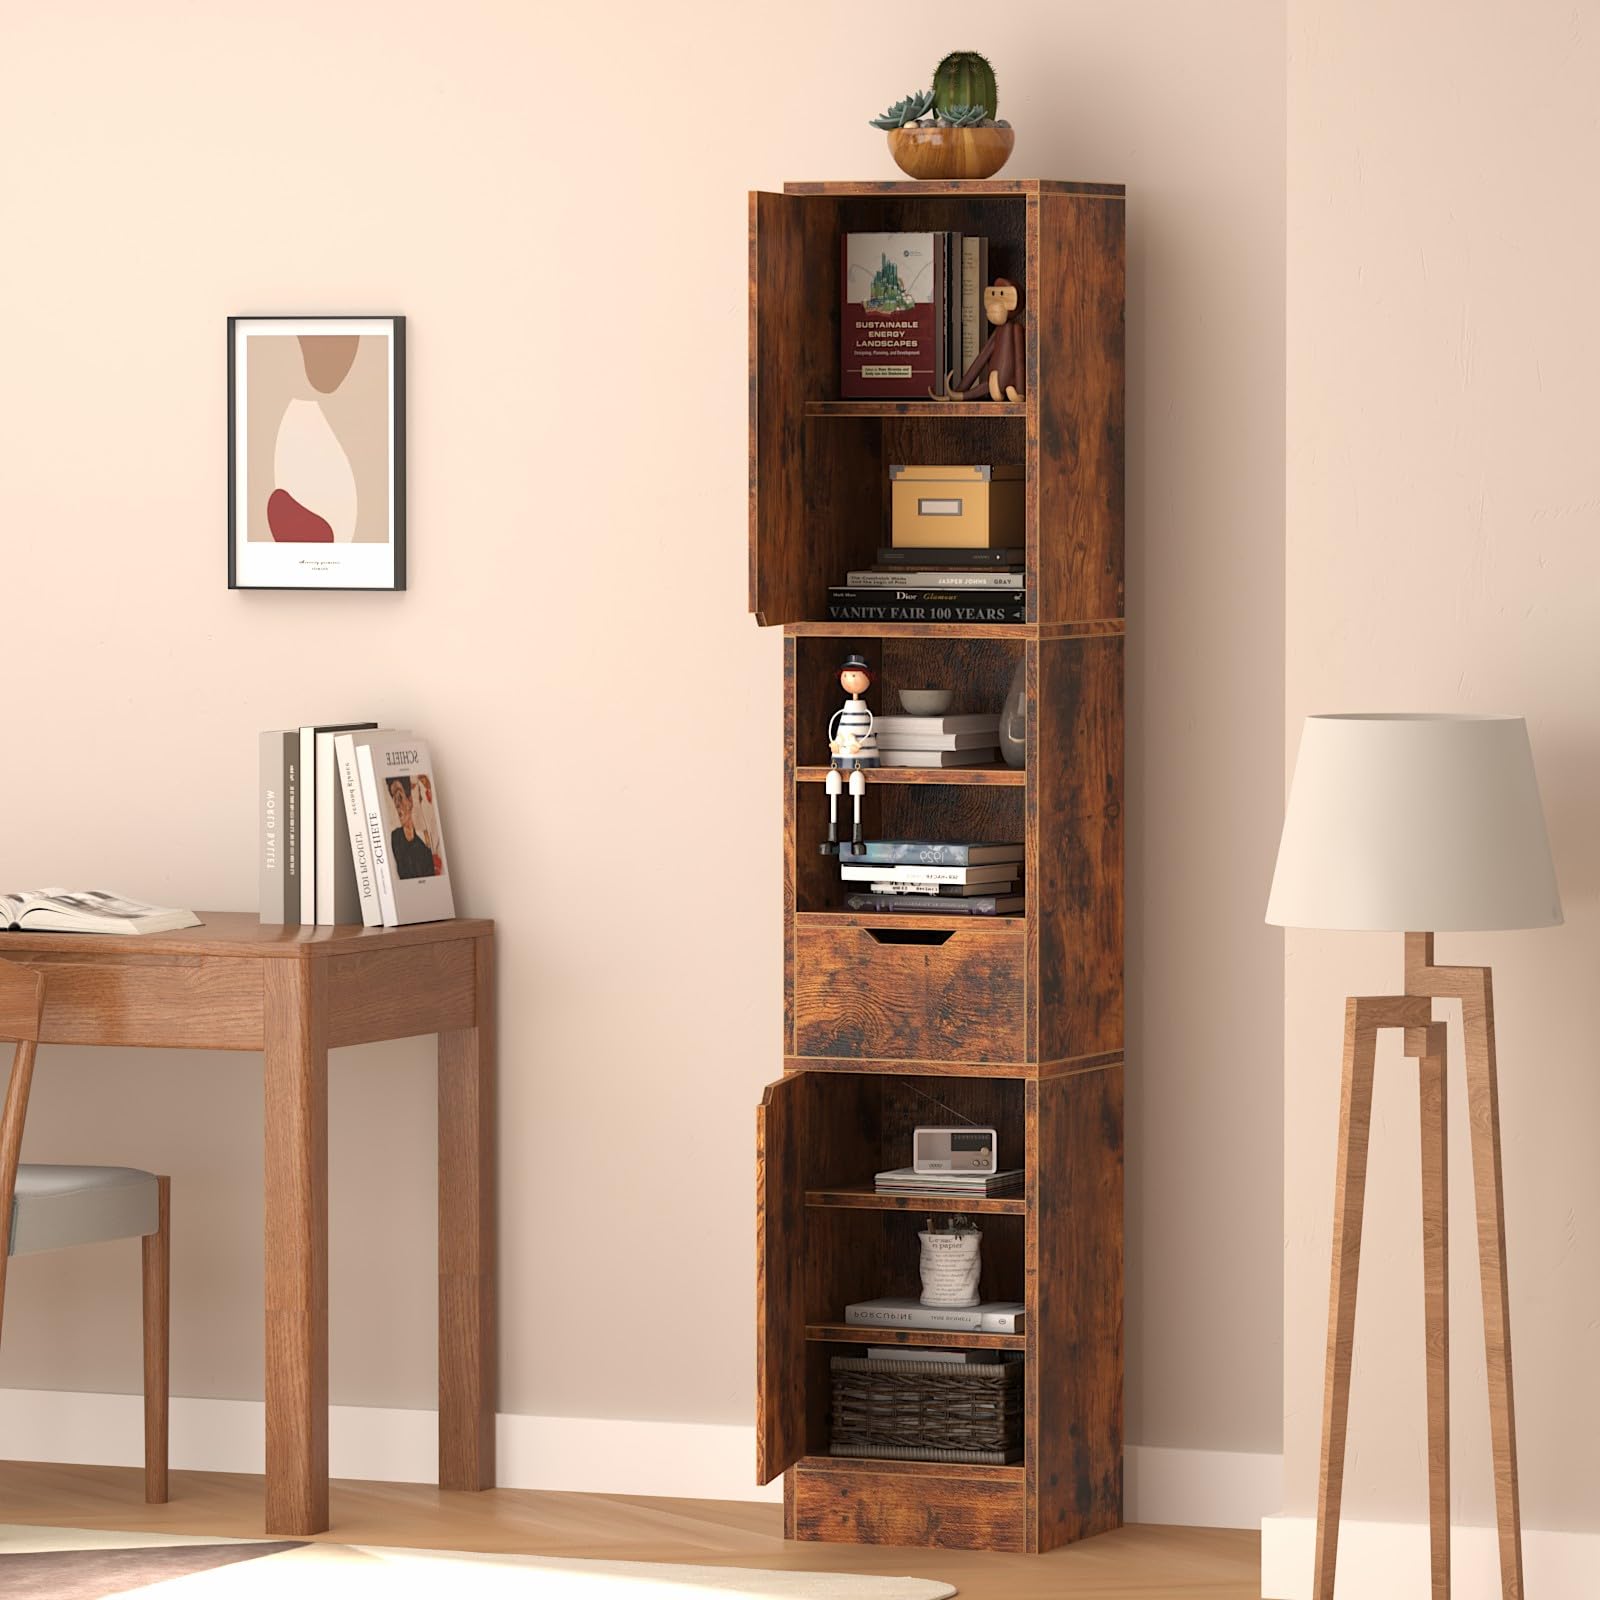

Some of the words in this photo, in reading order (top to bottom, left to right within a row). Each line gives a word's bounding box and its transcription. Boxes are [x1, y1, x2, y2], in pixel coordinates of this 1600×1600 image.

[855, 321, 919, 329] SUSTAINABLE
[896, 591, 918, 600] Dior
[829, 606, 887, 619] VANITY
[891, 607, 926, 619] FAIR
[930, 607, 952, 620] 100
[955, 608, 1006, 620] YEARS
